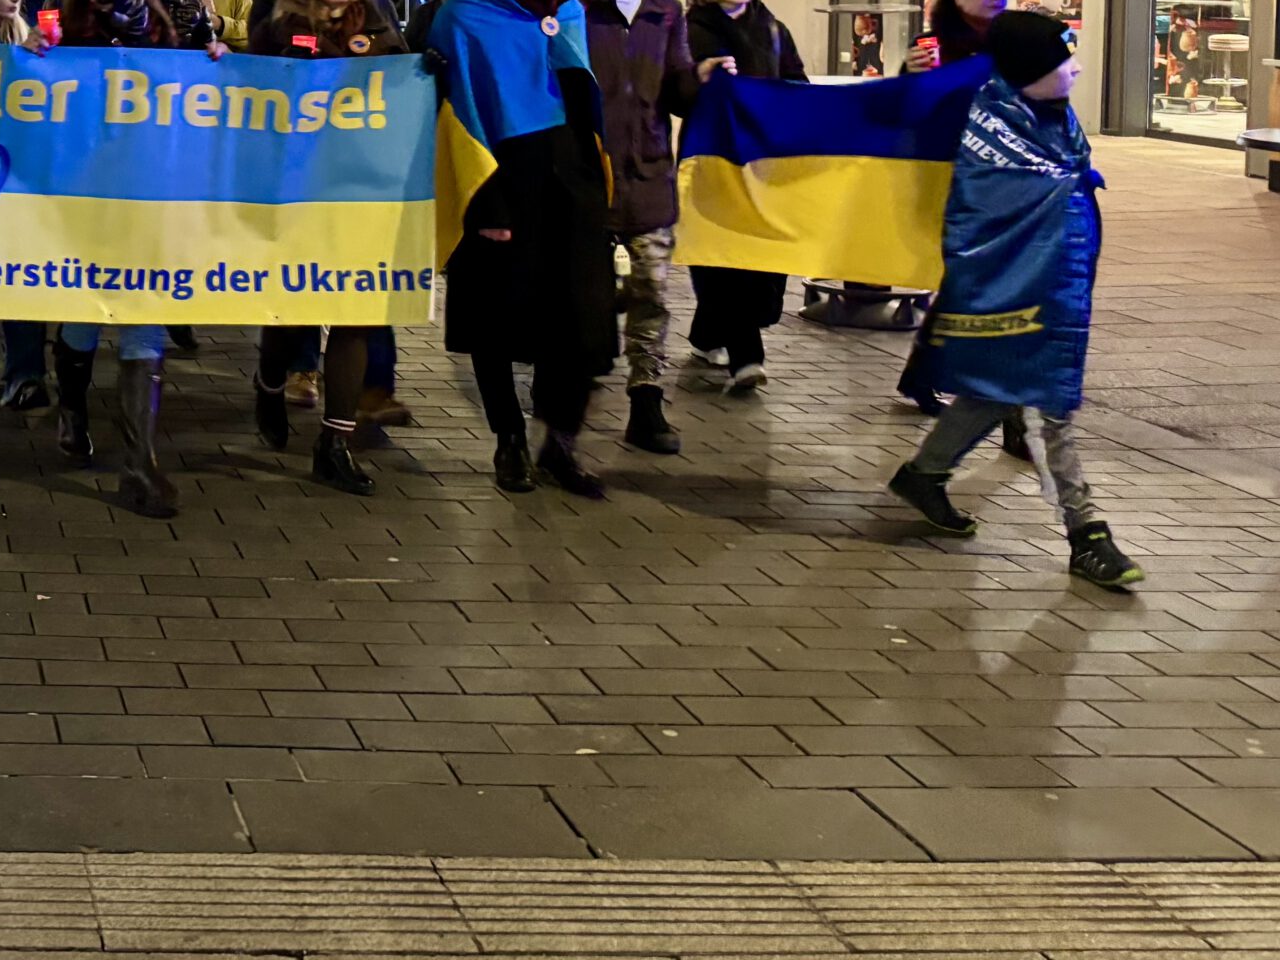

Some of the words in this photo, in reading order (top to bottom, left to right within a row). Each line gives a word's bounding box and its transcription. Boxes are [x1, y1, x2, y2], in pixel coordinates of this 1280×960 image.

[103, 69, 388, 133] Bremse!
[205, 261, 270, 292] der
[280, 262, 433, 293] Ukraine
